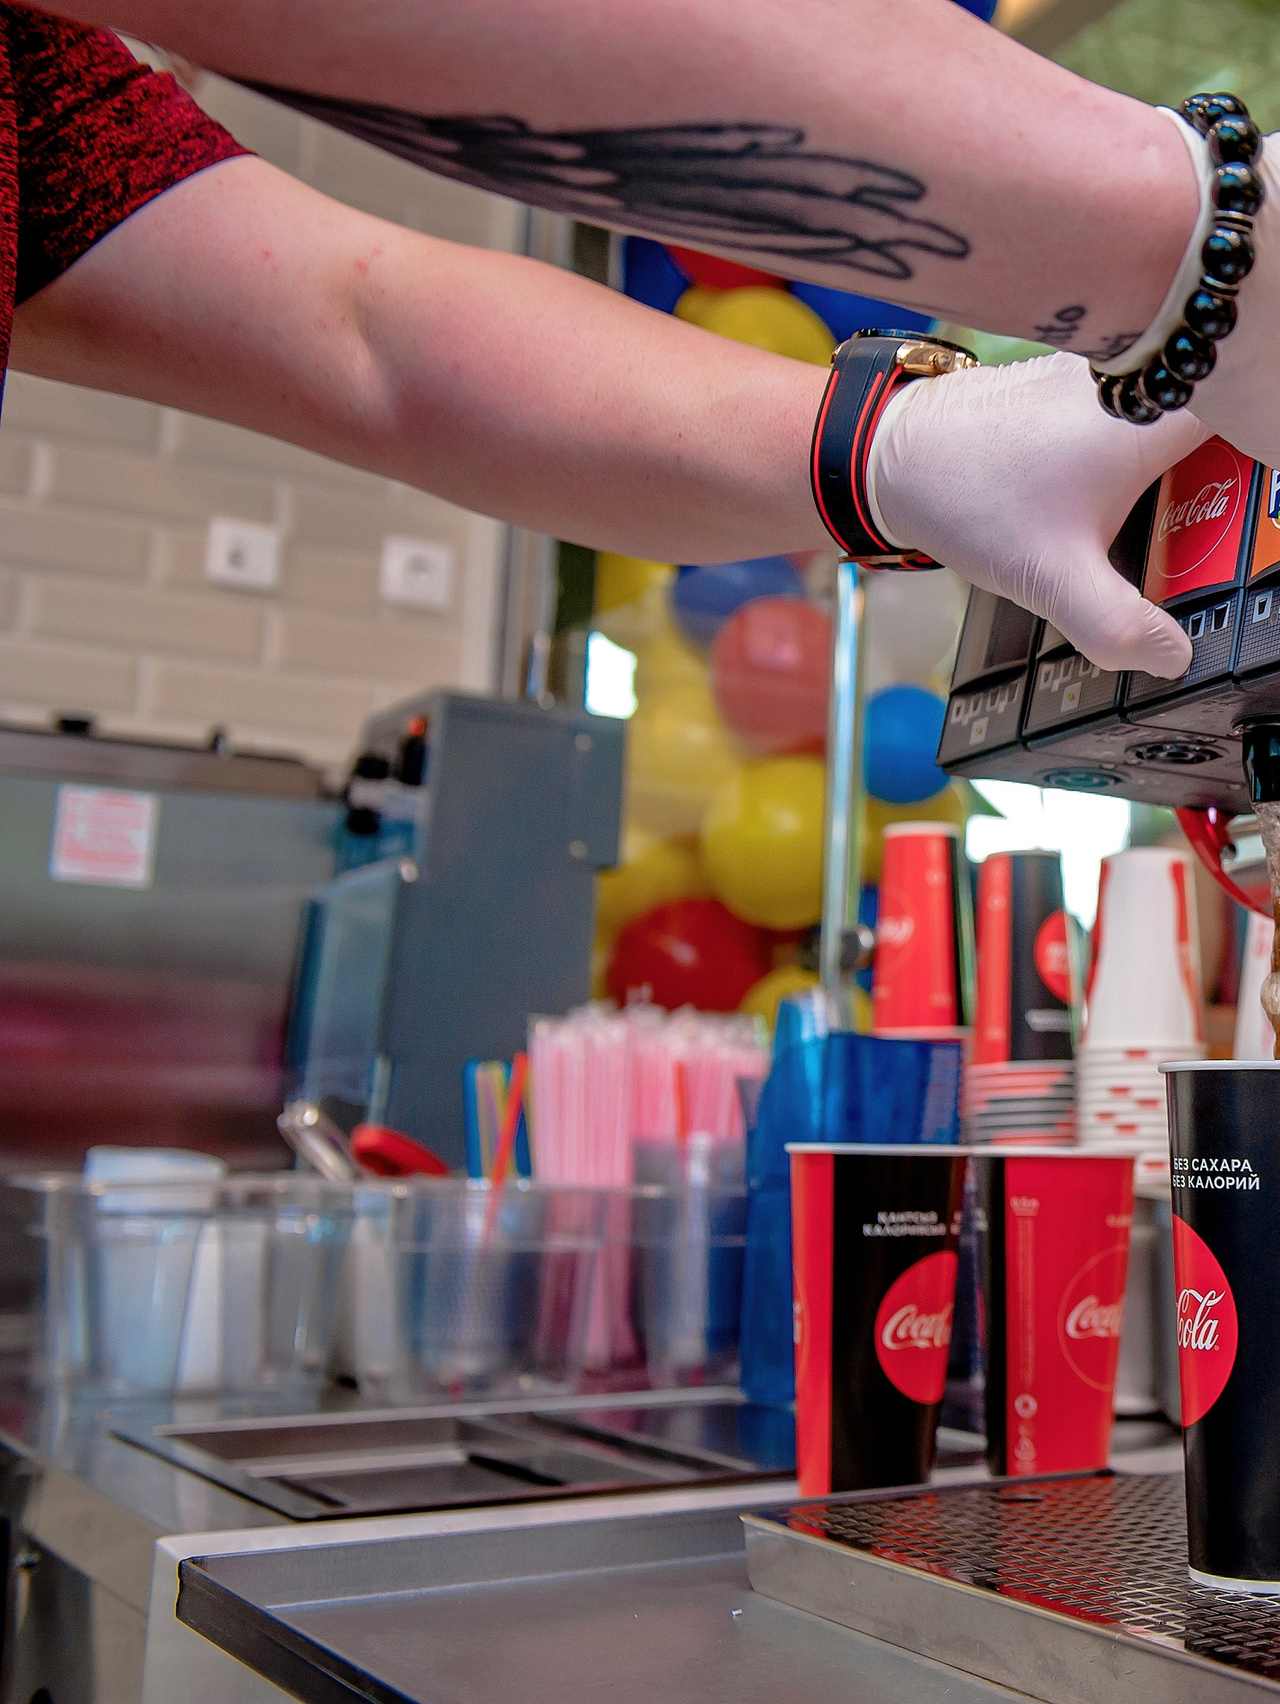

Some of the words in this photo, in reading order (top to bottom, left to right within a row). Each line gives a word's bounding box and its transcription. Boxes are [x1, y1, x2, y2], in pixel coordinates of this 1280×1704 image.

[1157, 477, 1238, 542] Coca-Cola
[1174, 1158, 1189, 1171] БЕЗ
[1191, 1158, 1253, 1172] САХАРА
[1172, 1174, 1186, 1188] БЕЗ
[1187, 1173, 1260, 1190] КАЛОРИЙ
